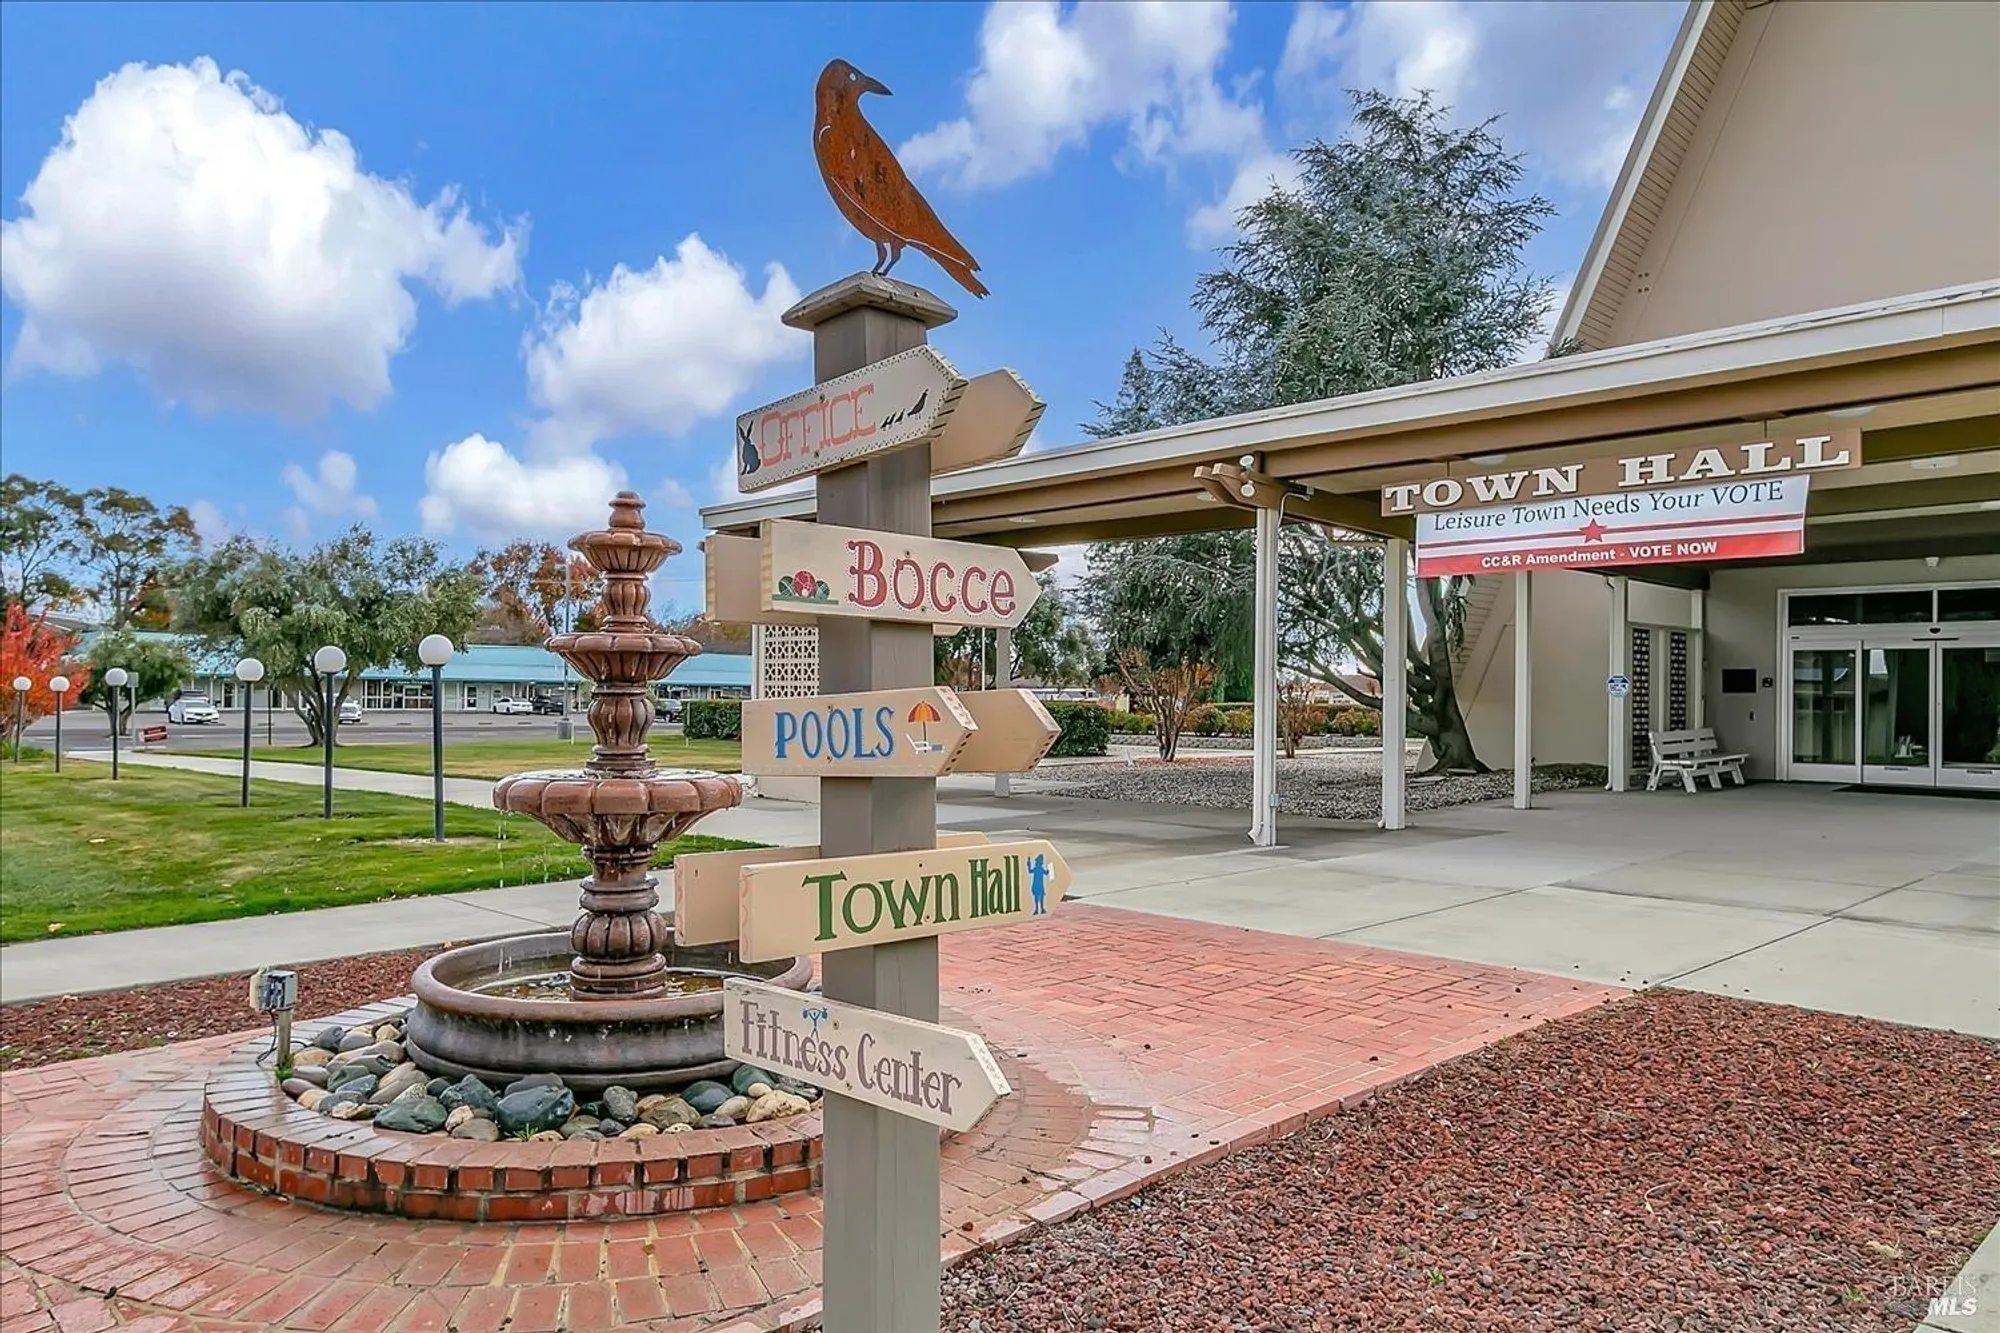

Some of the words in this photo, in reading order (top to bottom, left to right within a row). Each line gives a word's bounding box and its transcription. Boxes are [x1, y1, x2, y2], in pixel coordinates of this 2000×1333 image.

[759, 383, 876, 466] OFFICE
[1385, 463, 1584, 512] TOWN
[1618, 435, 1850, 487] HALL
[1434, 512, 1506, 531] Leisure
[1512, 504, 1566, 525] Town
[1573, 493, 1640, 517] Needs
[1649, 492, 1704, 512] Your
[1711, 480, 1783, 505] VOTE
[847, 540, 1016, 617] Bocce
[1481, 555, 1522, 568] CC&R
[1526, 549, 1616, 565] Amendment
[1629, 544, 1672, 558] VOTE
[1677, 541, 1718, 555] NOW
[775, 706, 895, 759] POOLS
[801, 870, 961, 942] Town
[968, 855, 1022, 918] Hall
[740, 1000, 849, 1081] Fitness
[857, 1033, 962, 1115] Center
